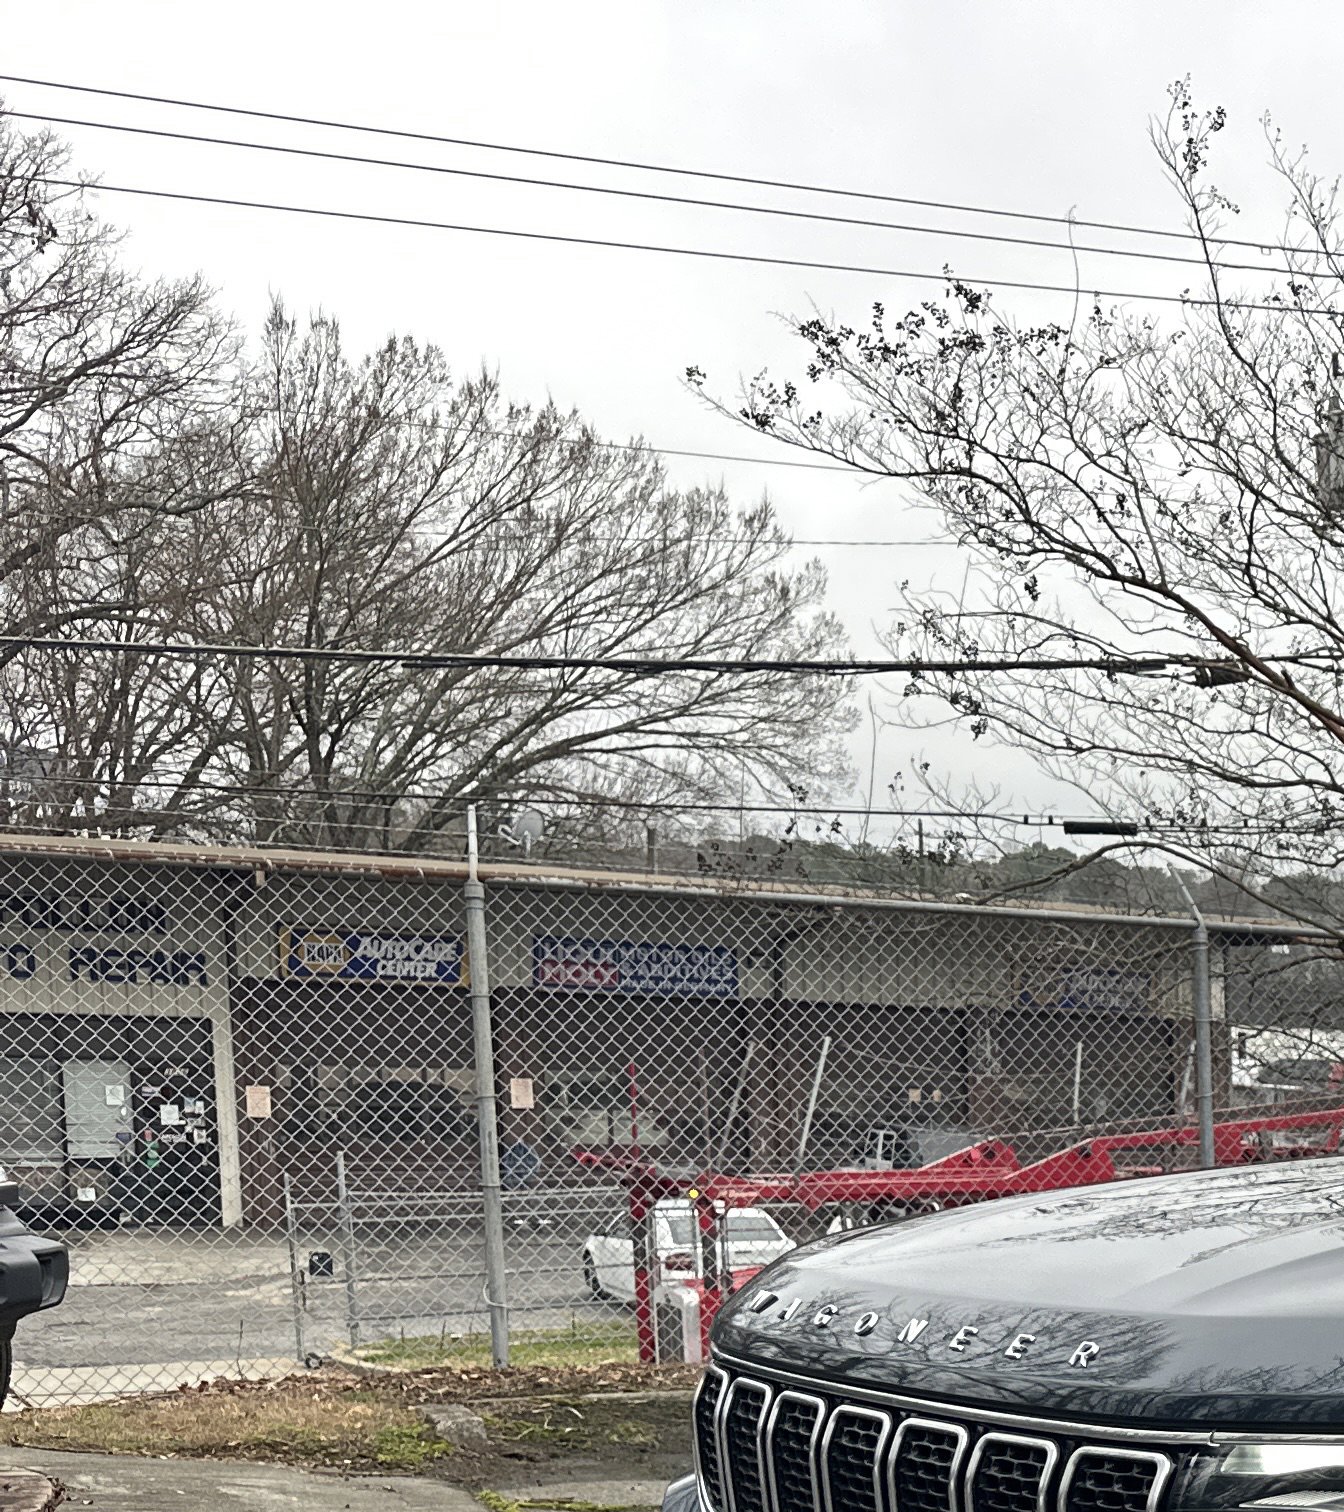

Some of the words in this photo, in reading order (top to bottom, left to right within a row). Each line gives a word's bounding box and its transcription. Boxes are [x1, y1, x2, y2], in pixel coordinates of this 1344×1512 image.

[356, 937, 458, 961] AUTOCARE
[69, 948, 208, 986] REPAIR
[376, 961, 438, 977] CENTER
[750, 1288, 1101, 1370] WAGONEER
